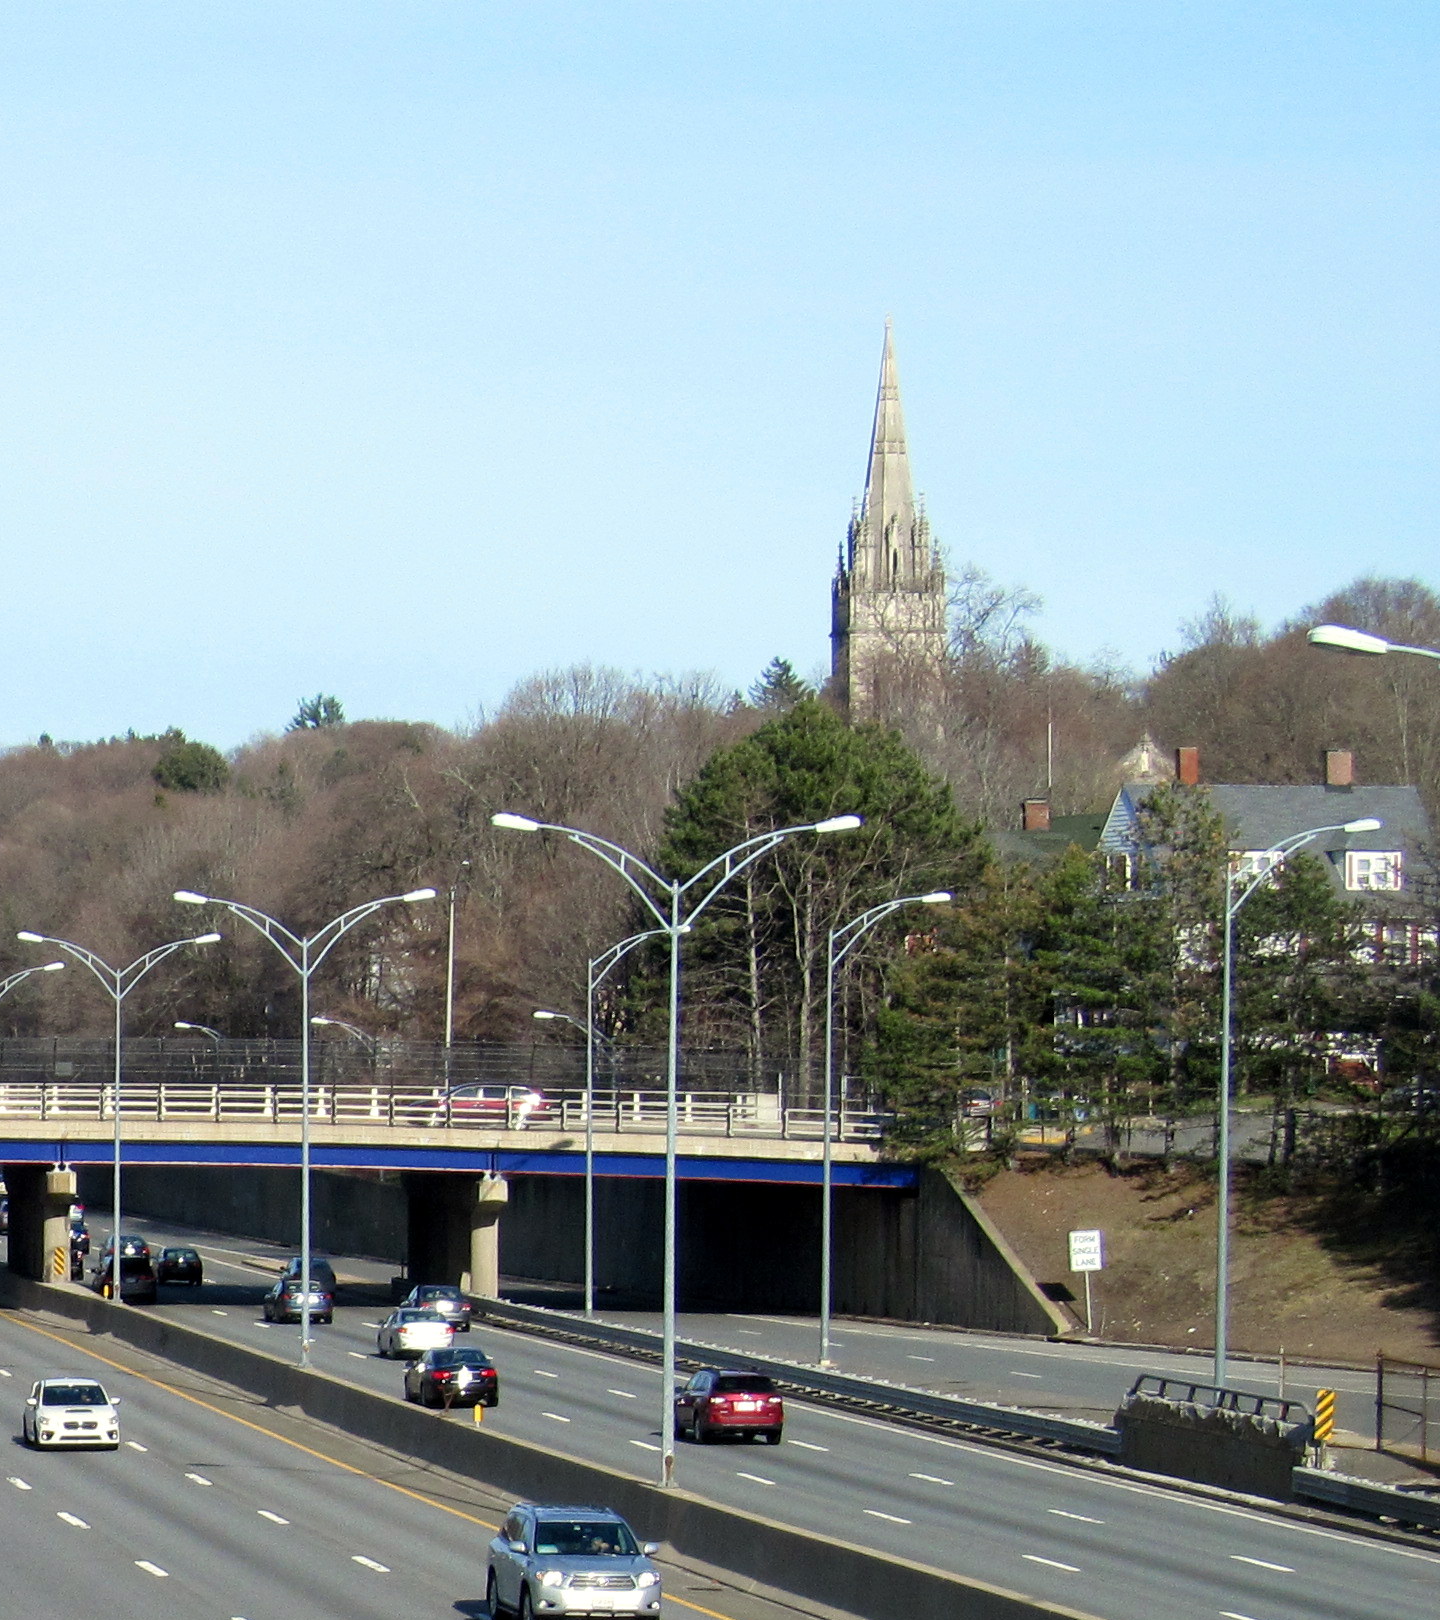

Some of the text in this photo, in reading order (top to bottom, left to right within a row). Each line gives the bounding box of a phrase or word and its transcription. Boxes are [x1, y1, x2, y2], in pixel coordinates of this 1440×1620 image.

[1073, 1235, 1095, 1244] FORM
[1072, 1246, 1099, 1255] SINGLE
[1075, 1257, 1097, 1267] LANE
